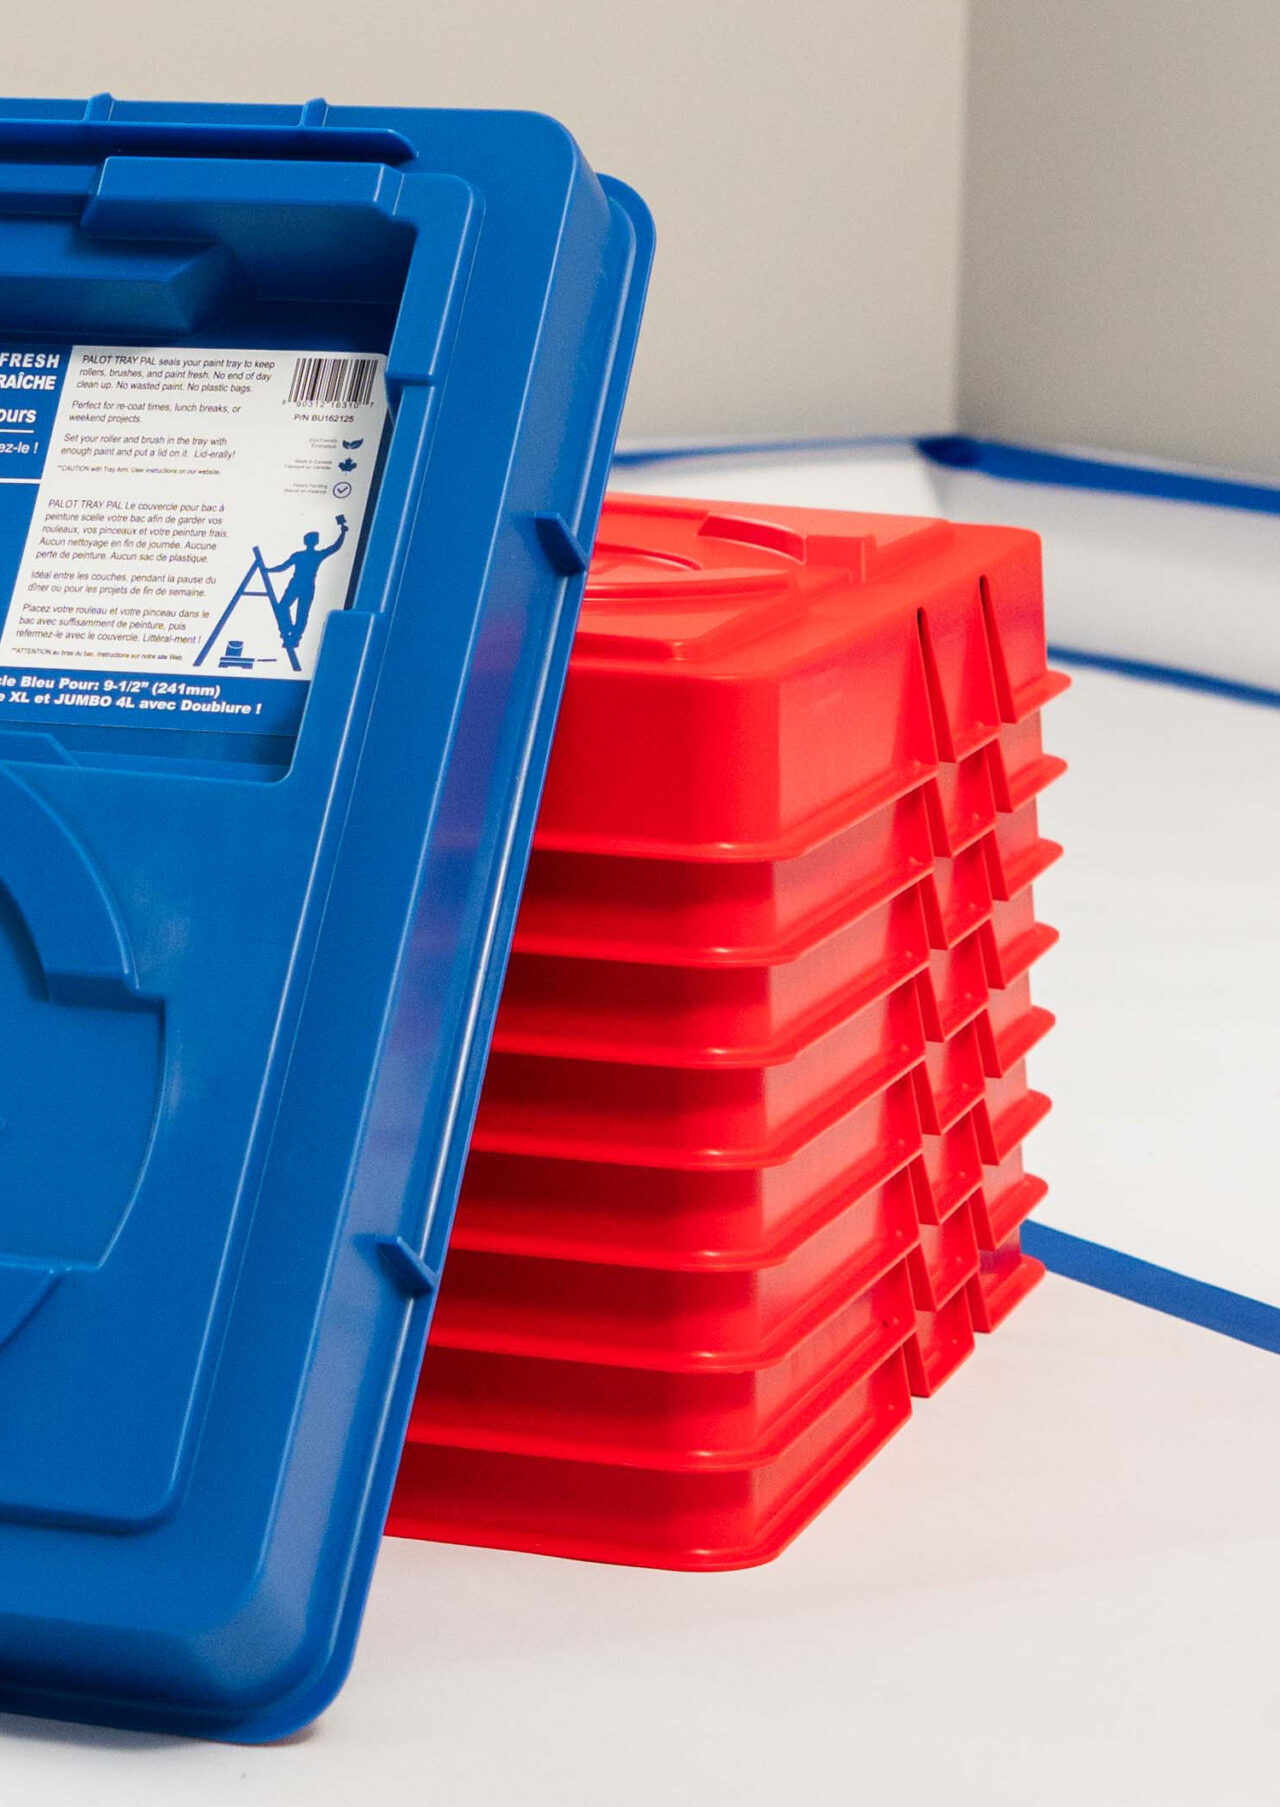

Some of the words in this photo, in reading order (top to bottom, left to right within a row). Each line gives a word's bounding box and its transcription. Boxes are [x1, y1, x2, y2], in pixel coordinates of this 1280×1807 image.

[82, 353, 114, 364] PALOT
[113, 354, 139, 364] TRAY
[139, 355, 155, 365] PAL
[158, 357, 180, 365] seals
[182, 359, 201, 368] your
[202, 359, 224, 368] paint
[225, 359, 242, 369] tray
[243, 359, 252, 367] to
[254, 359, 275, 369] keep
[146, 369, 163, 377] and
[163, 370, 185, 379] paint
[212, 370, 226, 379] No
[226, 371, 244, 380] end
[244, 371, 255, 380] of
[255, 371, 272, 382] day
[76, 379, 98, 388] clean
[115, 380, 128, 389] No
[130, 381, 161, 390] wasted
[186, 382, 199, 391] No
[200, 382, 228, 392] plastic
[71, 399, 101, 409] Perfect
[102, 400, 114, 409] for
[174, 402, 197, 412] lunch
[231, 405, 241, 413] or
[68, 413, 106, 422] weekend
[63, 432, 79, 442] Set
[79, 435, 99, 443] your
[99, 434, 122, 443] roller
[122, 435, 139, 443] and
[140, 435, 164, 444] brush
[166, 435, 174, 444] in
[176, 436, 190, 445] the
[191, 436, 208, 447] tray
[210, 437, 227, 445] with
[60, 447, 92, 456] enough
[92, 447, 115, 456] paint
[115, 447, 132, 456] and
[133, 448, 148, 458] put
[156, 448, 168, 456] lid
[168, 449, 180, 457] on
[19, 675, 55, 688] Bleu
[58, 677, 99, 690] Pour:
[151, 681, 220, 699] (241mm)
[8, 690, 30, 703] XL
[33, 693, 51, 704] et
[53, 693, 112, 706] JUMBO
[115, 695, 135, 708] 4L
[138, 699, 176, 710] avec
[179, 699, 251, 714] Doublure
